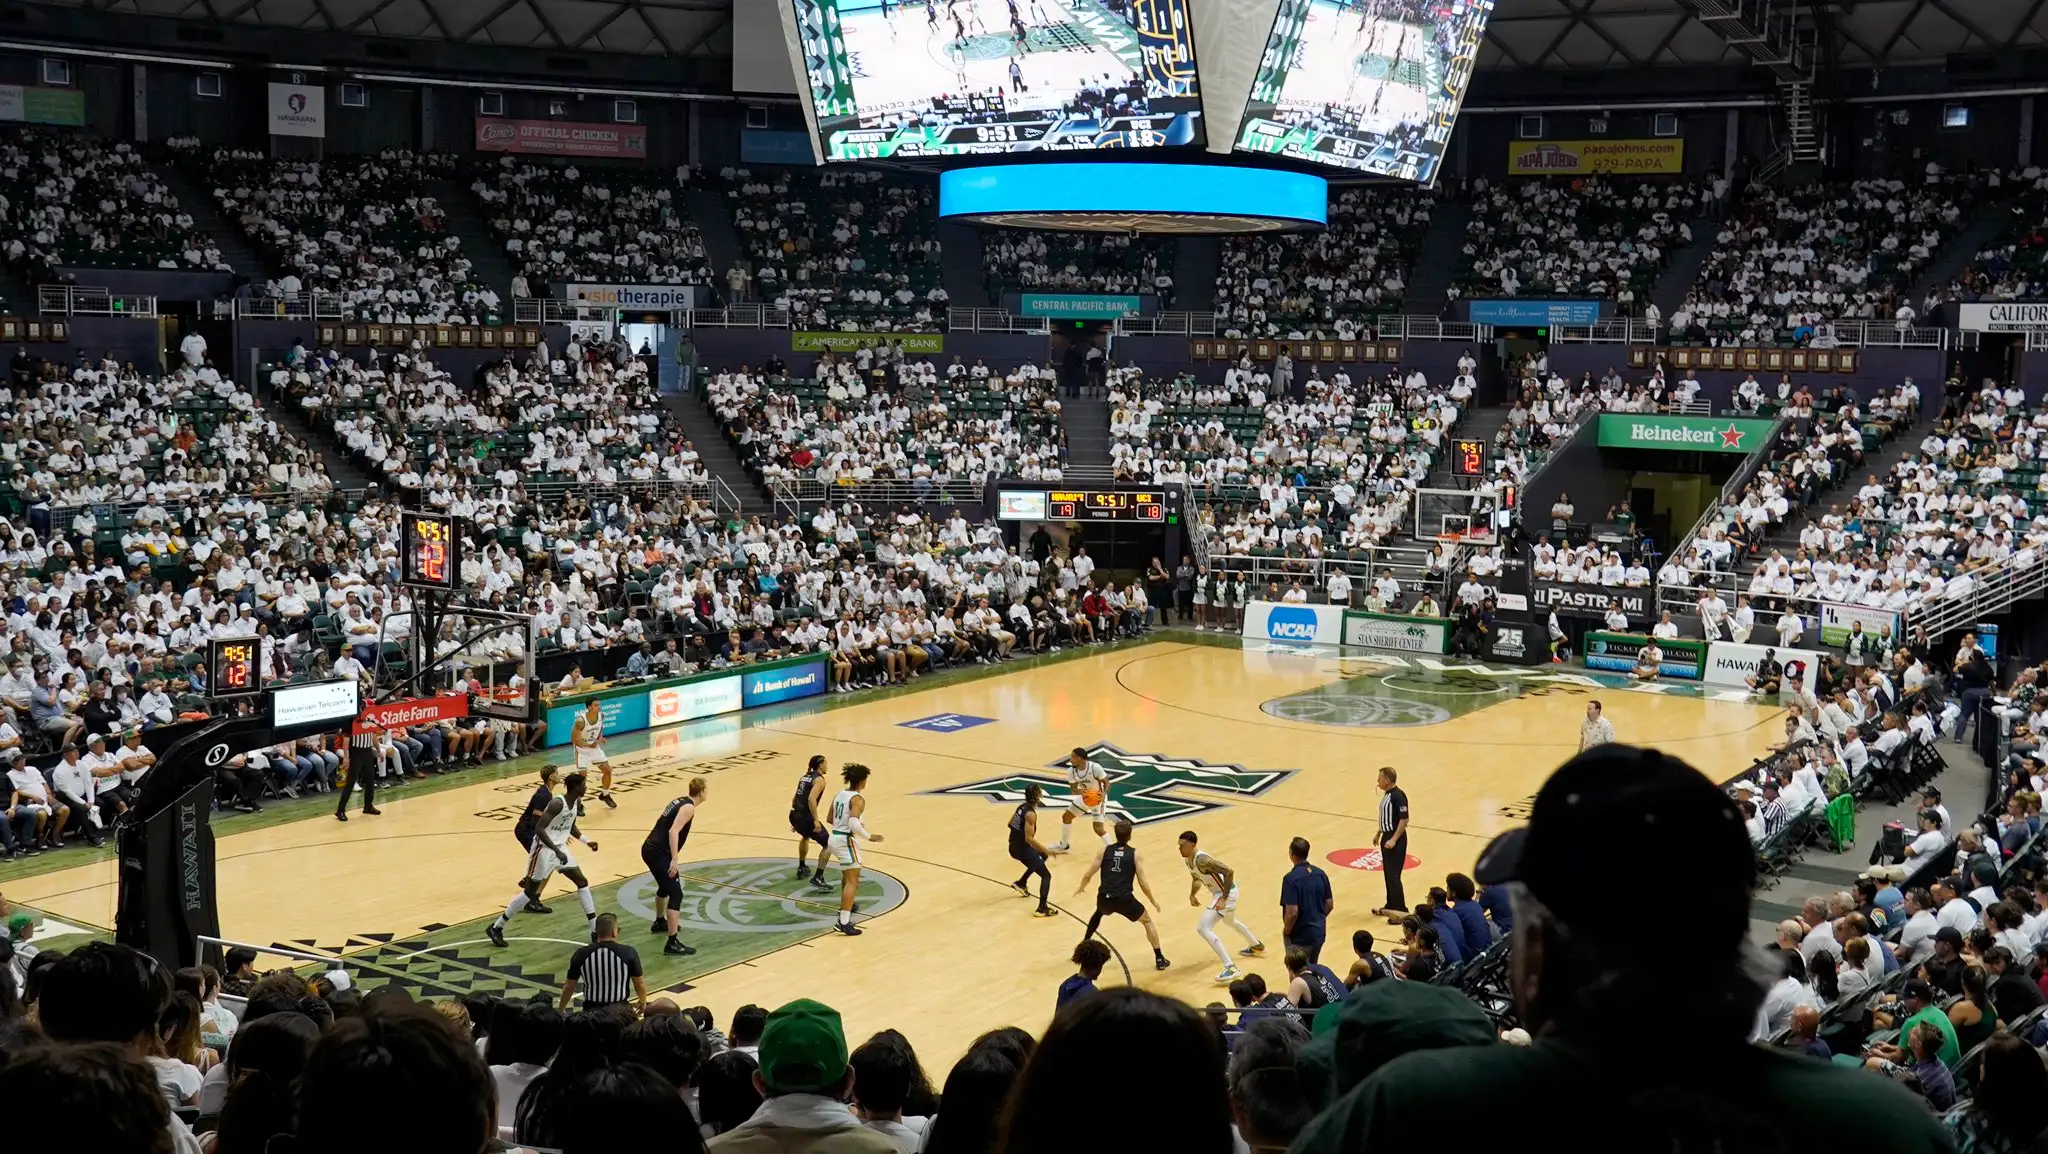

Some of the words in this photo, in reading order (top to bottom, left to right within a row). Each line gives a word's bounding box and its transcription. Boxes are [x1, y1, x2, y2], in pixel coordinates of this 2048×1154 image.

[800, 8, 808, 26] 3
[815, 7, 823, 25] 0
[829, 6, 837, 24] 8
[1140, 12, 1149, 32] 5
[1159, 10, 1167, 30] 1
[1174, 9, 1183, 29] 0
[804, 39, 817, 57] 10
[821, 38, 829, 55] 0
[835, 37, 843, 55] 0
[1143, 45, 1158, 66] 15
[1163, 44, 1172, 64] 0
[1179, 43, 1188, 64] 0
[809, 69, 823, 87] 23
[827, 69, 835, 86] 0
[841, 67, 849, 85] 4
[1146, 79, 1163, 99] 22
[1168, 78, 1176, 98] 0
[1183, 77, 1192, 97] 7
[815, 99, 829, 117] 32
[833, 98, 841, 116] 0
[846, 98, 854, 115] 0
[520, 126, 569, 139] OFFICIAL
[572, 129, 618, 141] CHICKEN
[976, 125, 1018, 142] 9:51
[1129, 129, 1155, 147] 18
[857, 141, 879, 159] 19
[1583, 143, 1675, 156] papajohns.com
[1517, 154, 1543, 168] PAPA
[1594, 157, 1663, 169] 979-PAPA
[1032, 300, 1070, 310] CENTRAL
[1072, 301, 1104, 311] PACIFIC
[1106, 302, 1129, 311] BANK
[910, 339, 938, 348] BANK
[1631, 424, 1715, 443] Heineken
[1461, 442, 1483, 454] 9:51
[1465, 455, 1479, 472] 12
[1096, 494, 1124, 507] 9:51
[1136, 494, 1152, 502] UCI
[1059, 504, 1072, 516] 19
[1147, 506, 1159, 518] 18
[417, 520, 449, 541] 9:51
[423, 544, 443, 579] 12
[1547, 587, 1643, 612] PASTRMI
[1272, 622, 1317, 638] NCAA
[1497, 628, 1524, 647] 25
[1358, 634, 1374, 645] STAN
[1374, 635, 1398, 648] SHERIFF
[1399, 638, 1425, 650] CENTER
[224, 645, 252, 662] 9:51
[229, 664, 246, 685] 12
[765, 680, 783, 691] Bank
[783, 678, 791, 688] of
[278, 704, 317, 714] Hawaiian
[318, 700, 346, 709] Telcom
[678, 748, 783, 776] CENTER
[834, 801, 845, 820] 10
[1111, 857, 1122, 872] 1
